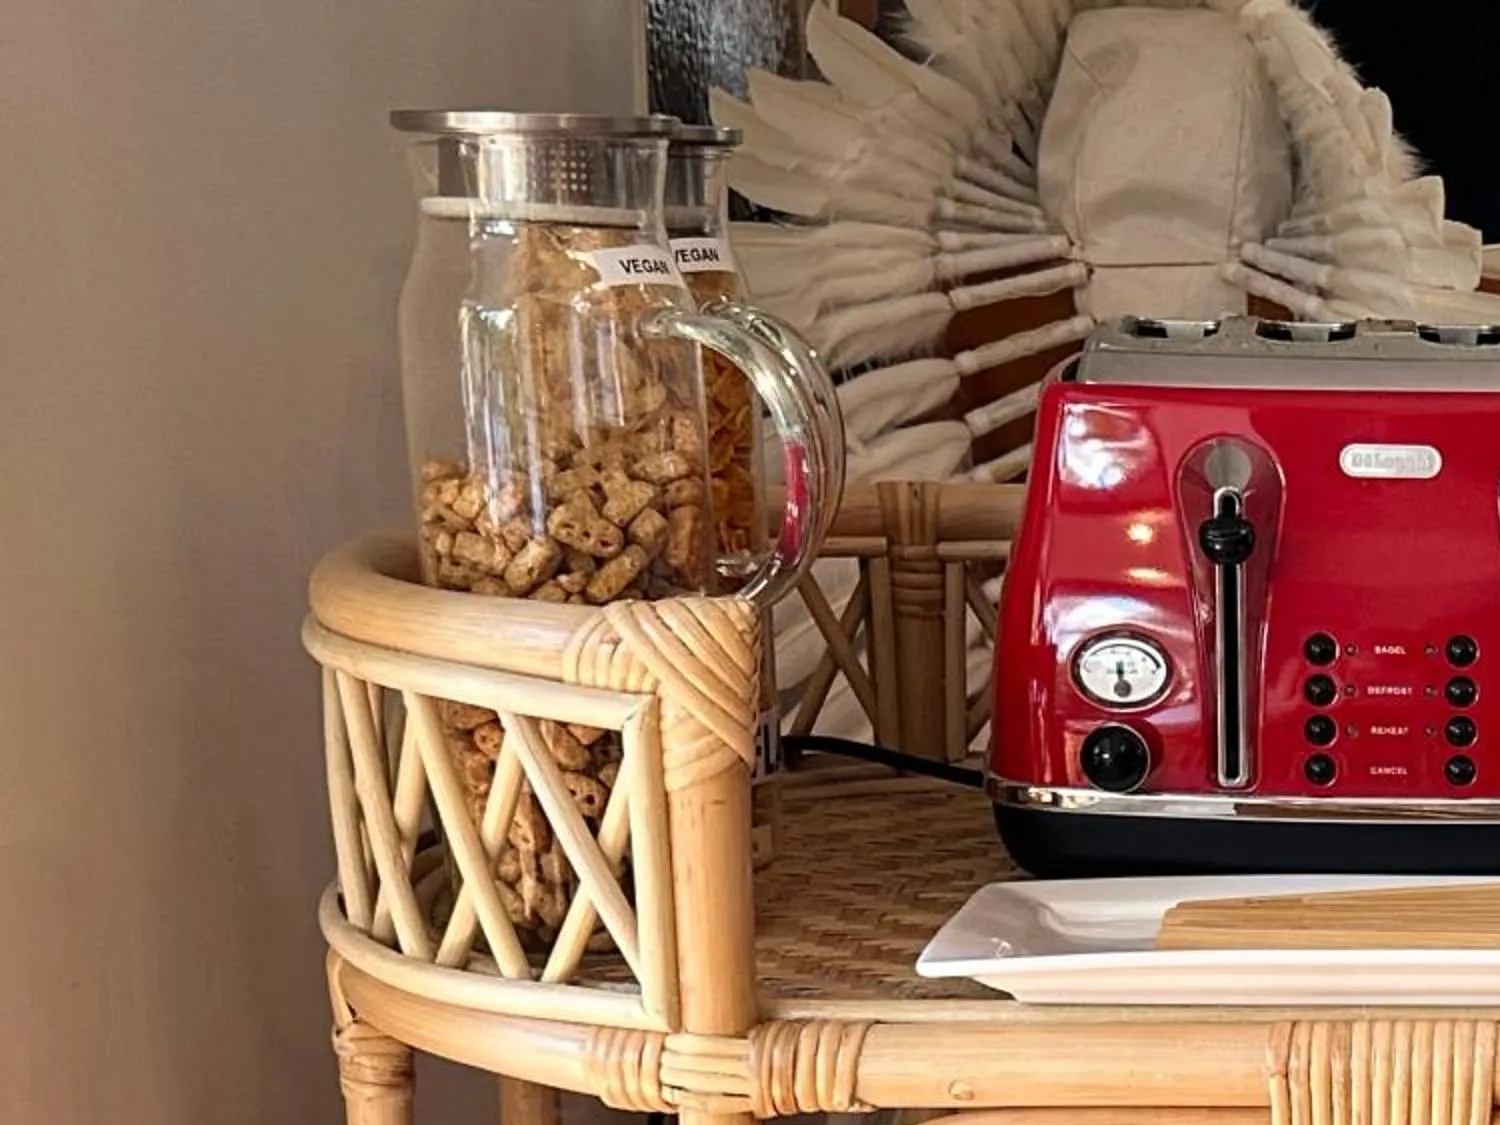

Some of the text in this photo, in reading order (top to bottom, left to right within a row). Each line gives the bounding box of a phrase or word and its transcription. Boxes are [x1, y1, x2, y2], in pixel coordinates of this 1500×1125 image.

[619, 259, 670, 275] VEGAN
[1374, 645, 1408, 655] BAGEL
[1367, 686, 1413, 695] DEFROST
[1369, 766, 1408, 775] CANCEL
